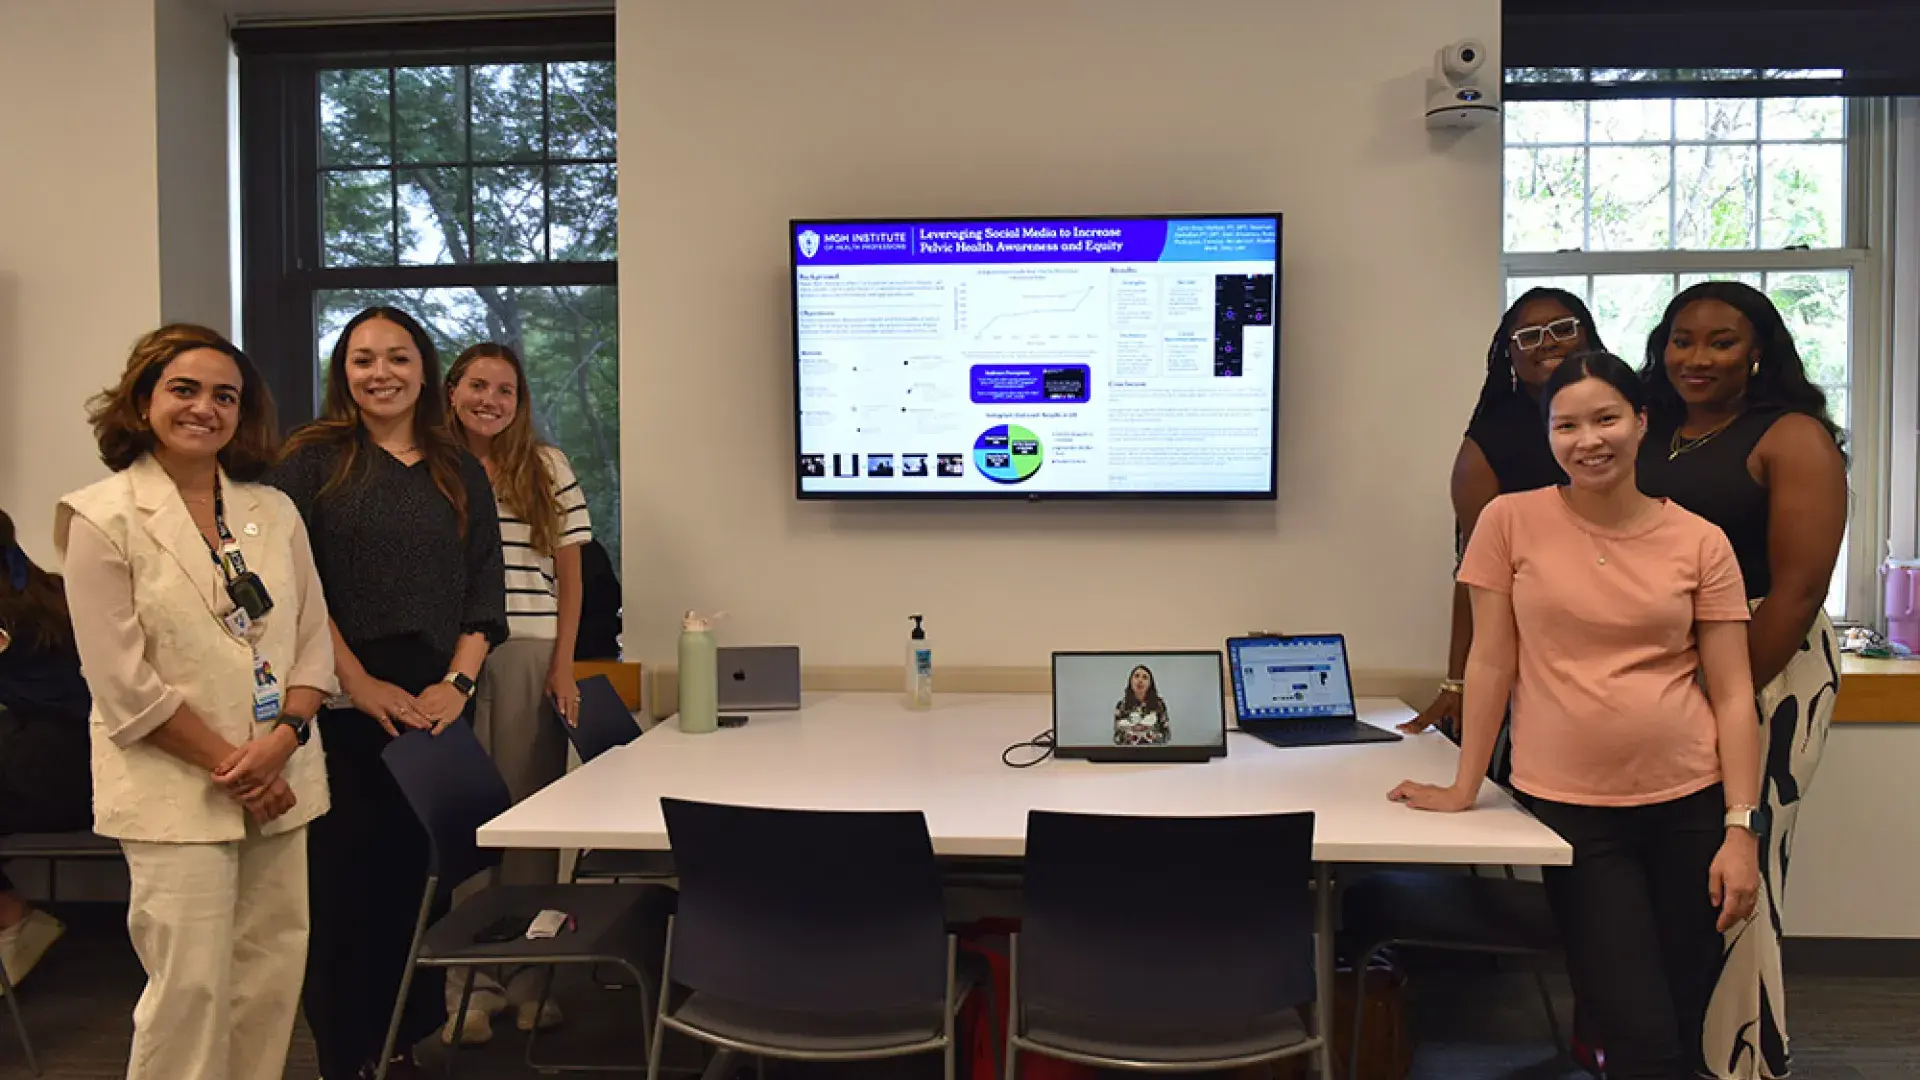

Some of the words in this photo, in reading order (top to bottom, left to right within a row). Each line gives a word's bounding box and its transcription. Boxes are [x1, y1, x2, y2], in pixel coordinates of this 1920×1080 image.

[852, 232, 907, 243] INSTITUTE
[920, 228, 983, 241] Leveraging
[985, 228, 1020, 239] Social
[1023, 227, 1057, 239] Media
[1060, 228, 1072, 238] to
[1074, 226, 1122, 238] Increase
[920, 242, 953, 254] Pelvic
[956, 241, 993, 252] Health
[996, 241, 1059, 252] Awareness
[1061, 240, 1082, 251] and
[1085, 240, 1123, 254] Equity
